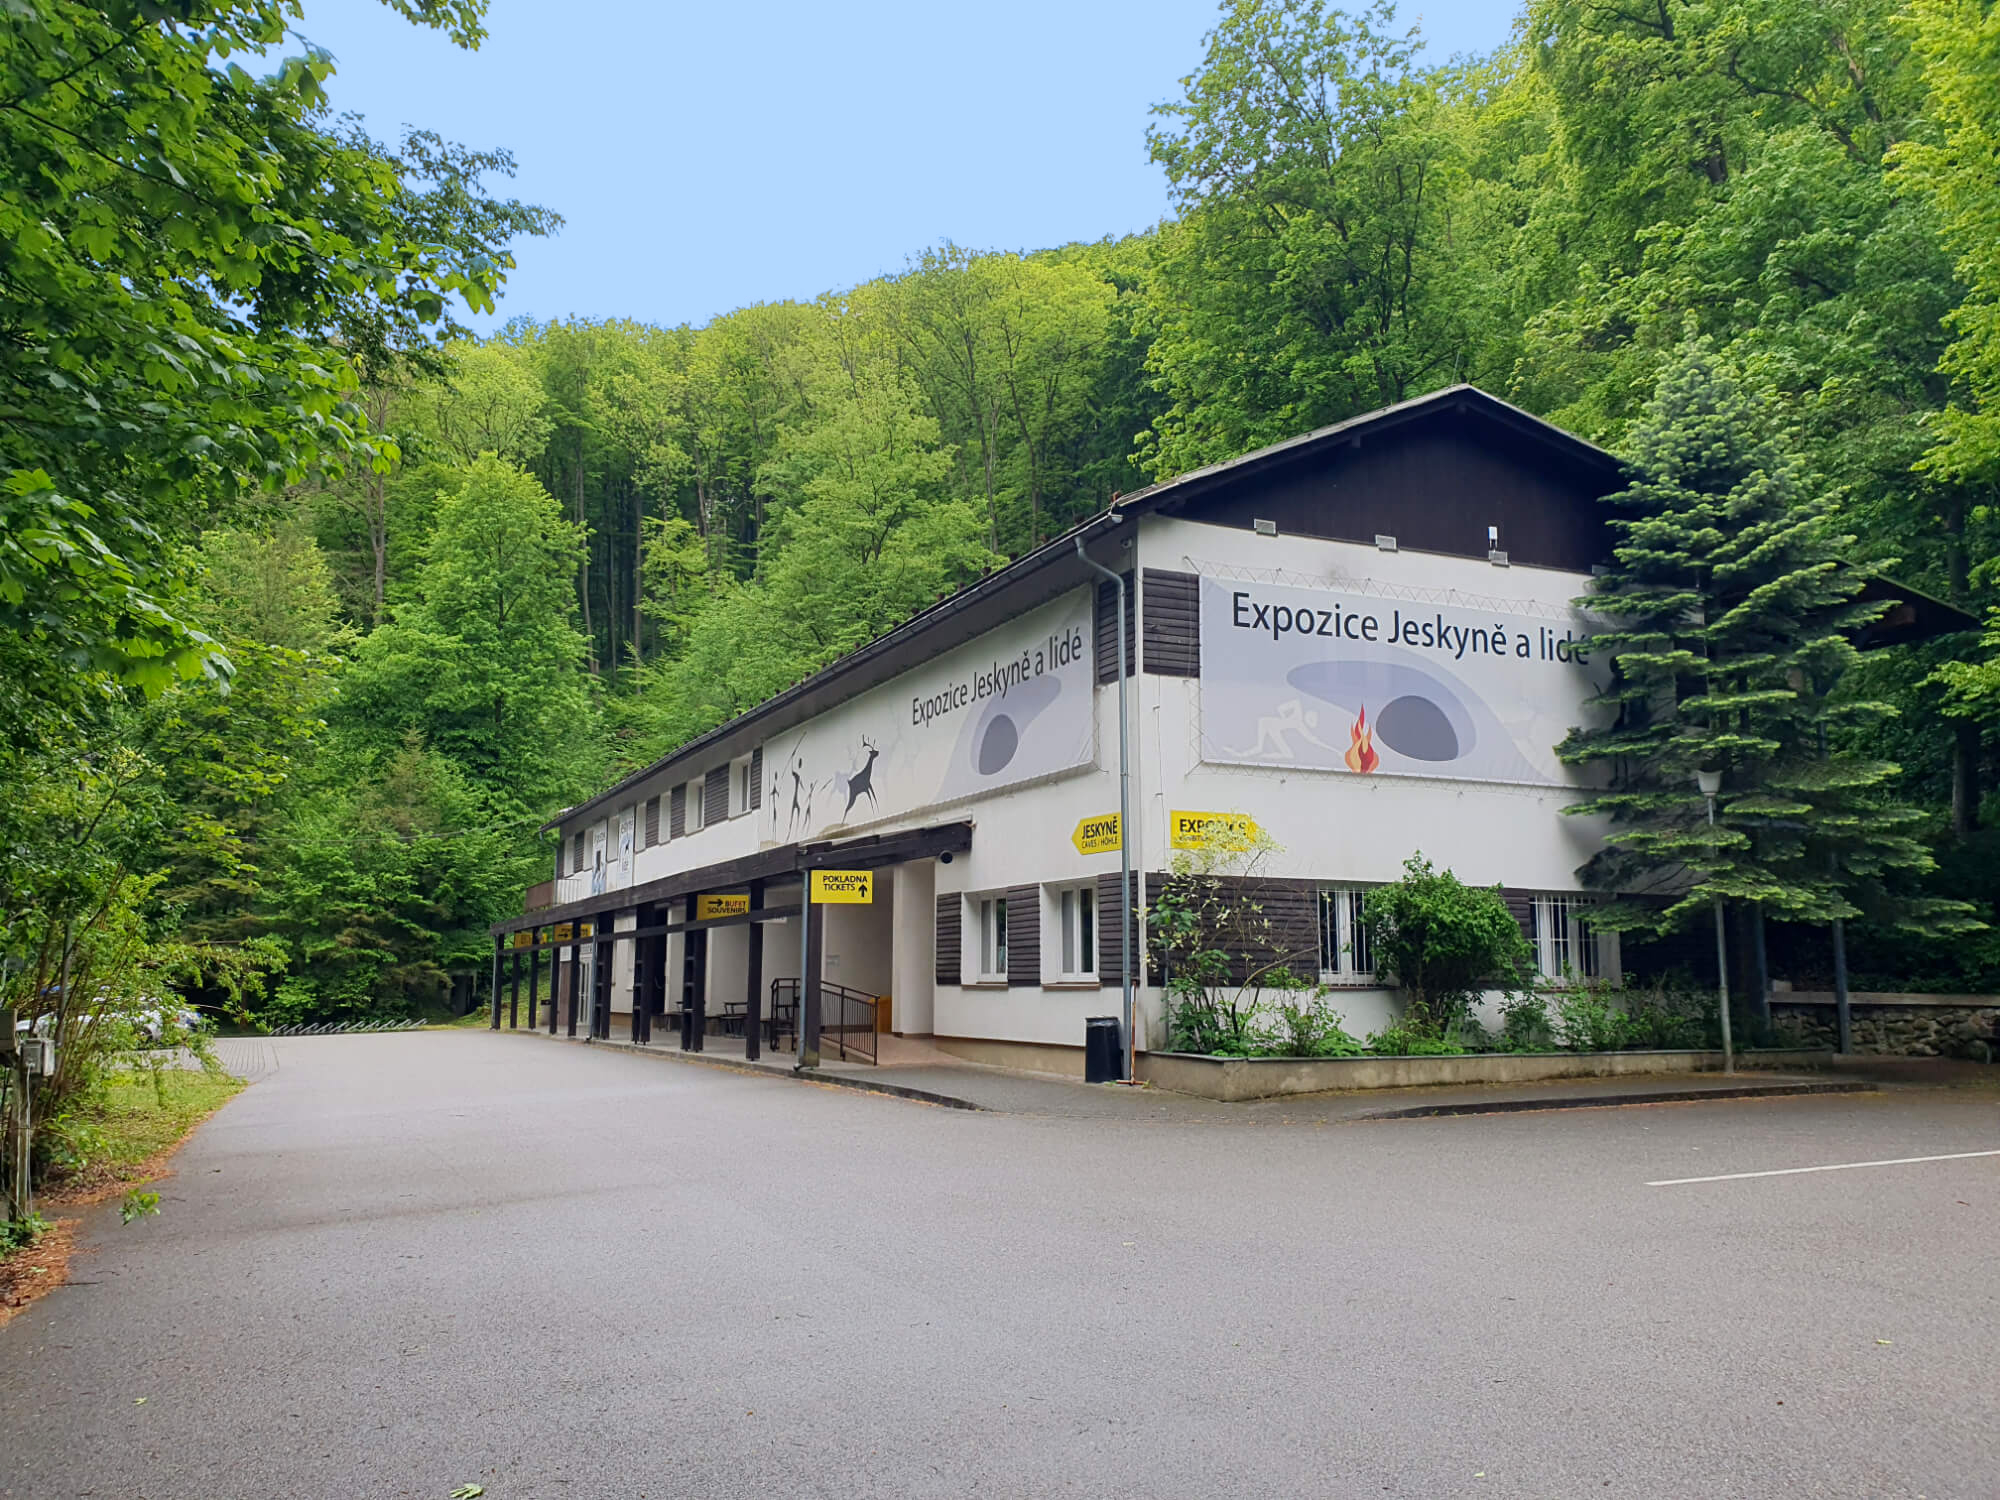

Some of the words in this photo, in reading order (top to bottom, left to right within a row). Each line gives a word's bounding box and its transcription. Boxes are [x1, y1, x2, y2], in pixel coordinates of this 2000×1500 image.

[1232, 591, 1379, 640] Expozice
[1388, 610, 1507, 660] Jeskyně
[1516, 633, 1531, 659] a
[1540, 626, 1590, 665] lidé
[912, 682, 968, 728] Expozice
[970, 650, 1030, 699] Jeskyně
[1035, 651, 1044, 676] a
[1049, 627, 1082, 671] lidé
[1082, 816, 1118, 840] JESKYNĚ
[823, 875, 868, 883] POKLADNA
[823, 883, 856, 891] TICKETS
